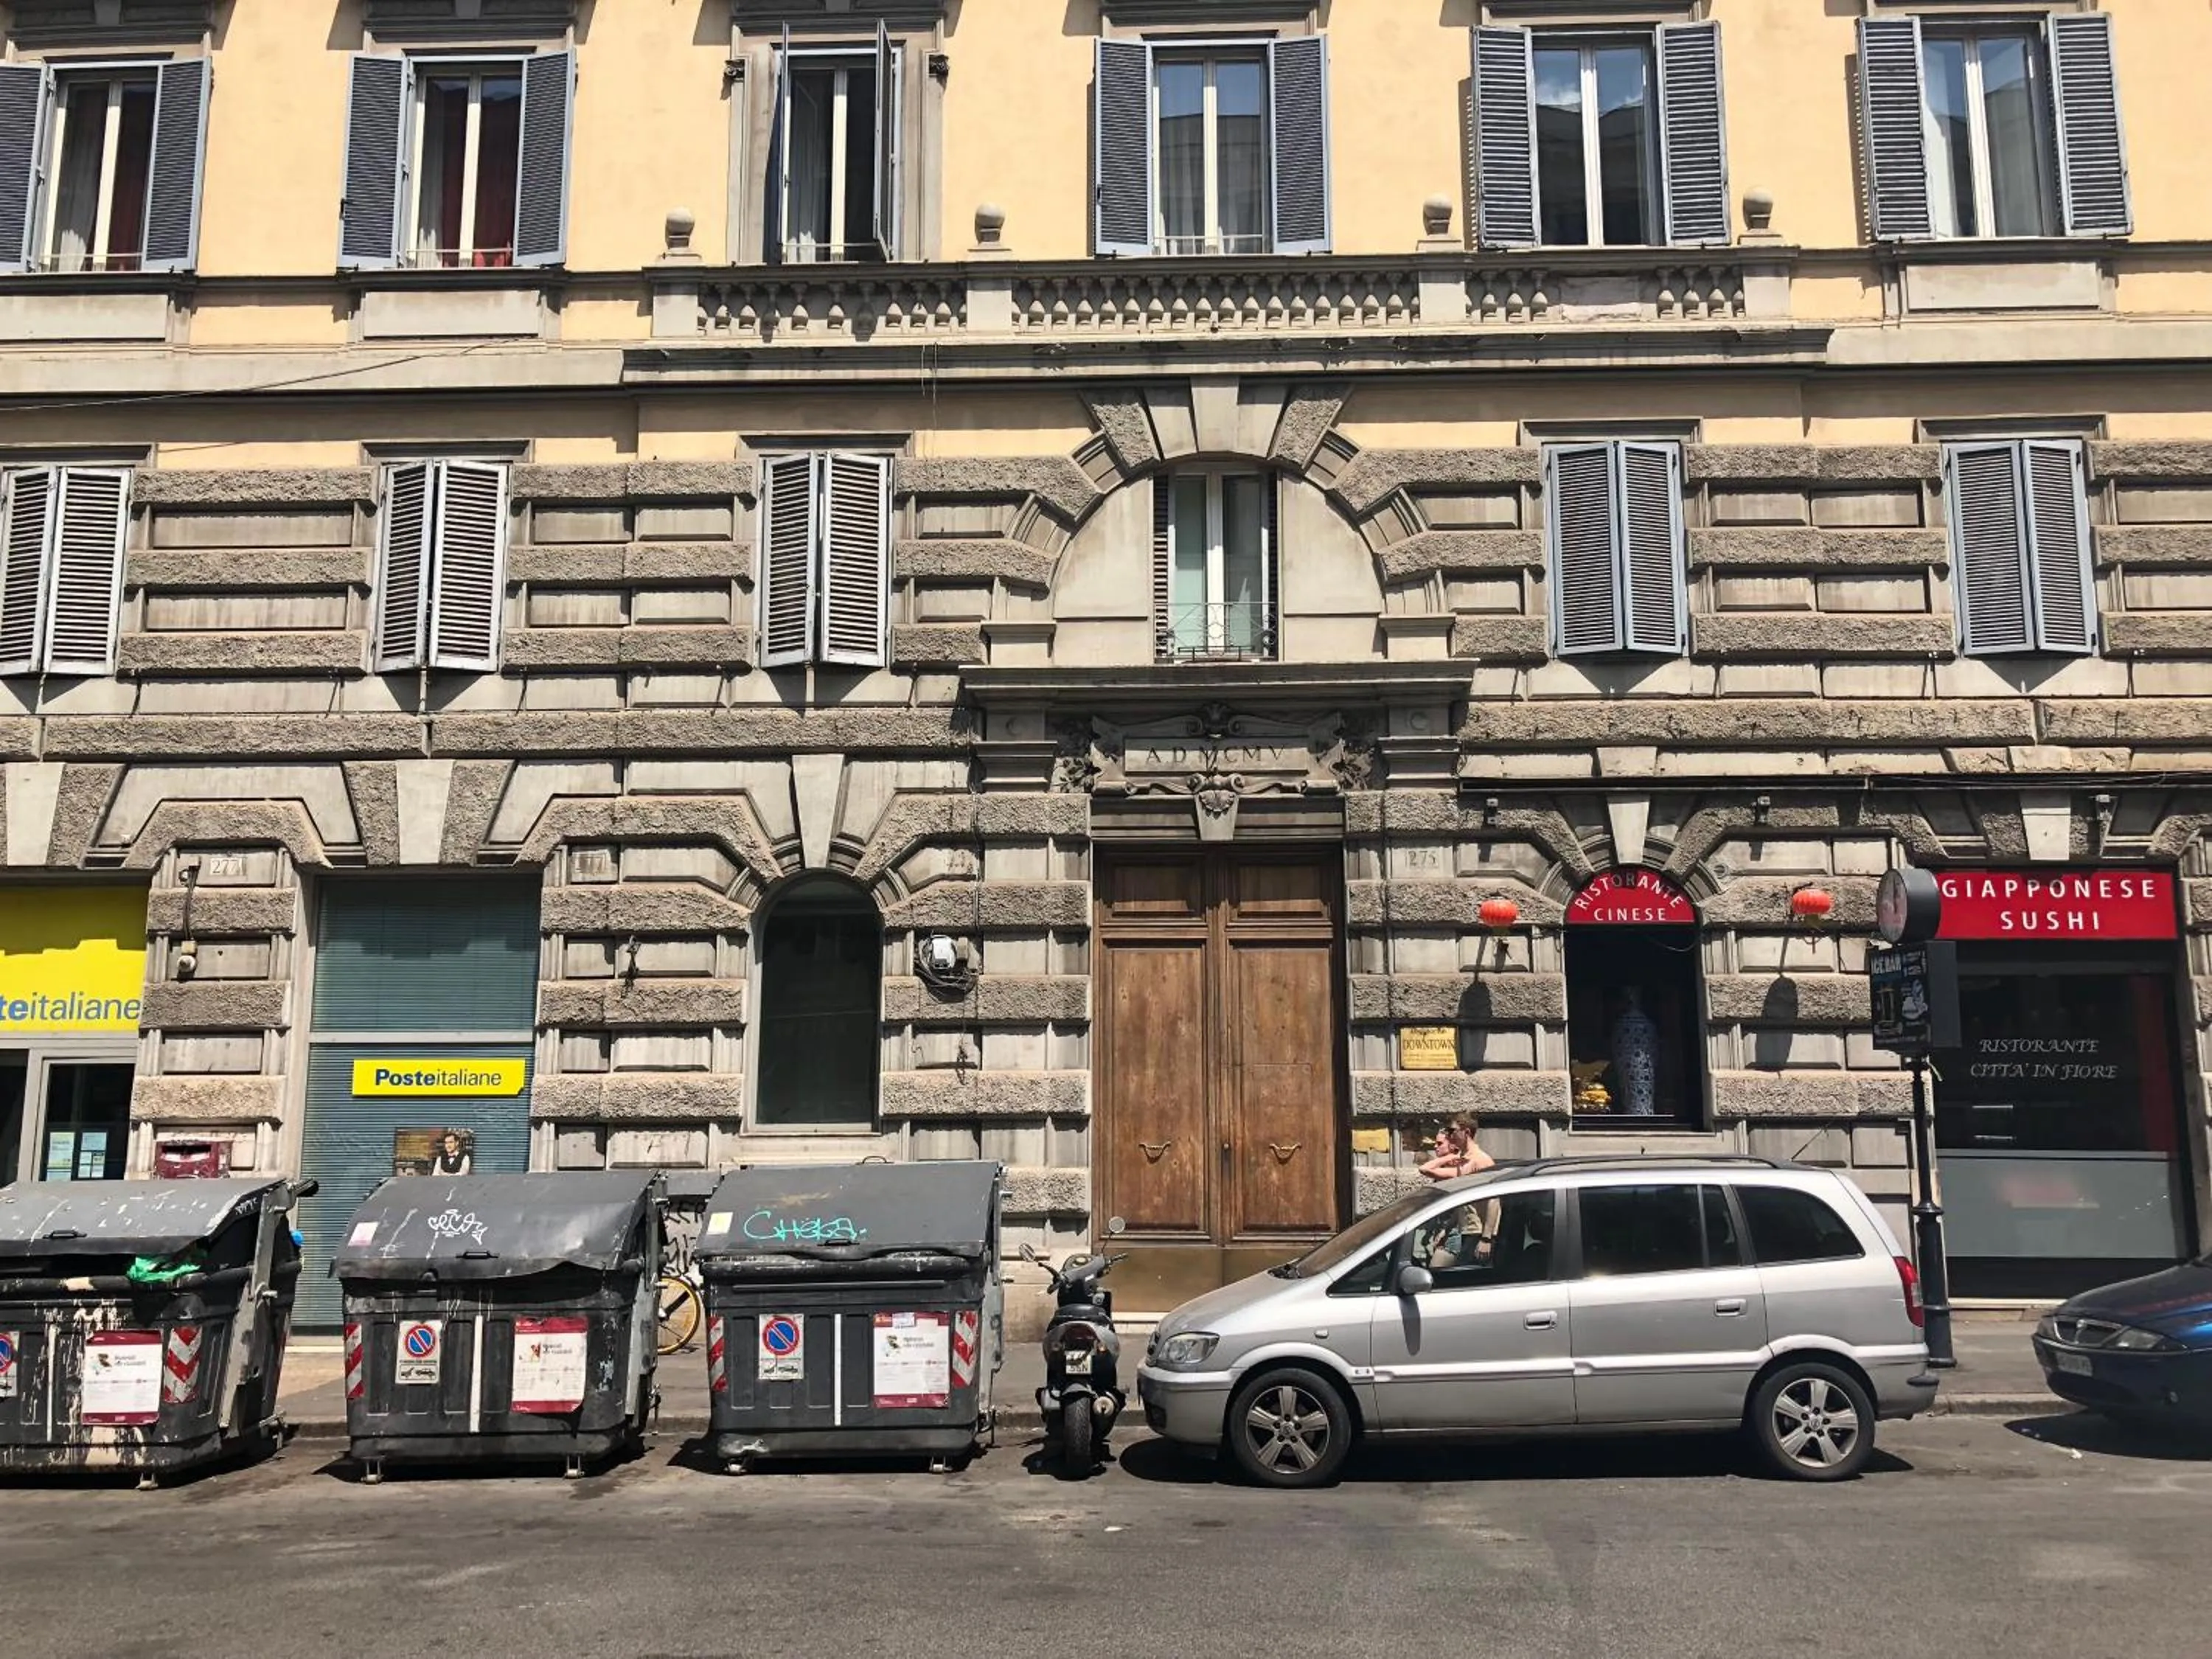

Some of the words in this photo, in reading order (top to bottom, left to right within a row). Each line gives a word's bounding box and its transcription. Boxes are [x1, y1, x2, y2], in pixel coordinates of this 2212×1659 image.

[1574, 873, 1683, 911] RISTORANTE
[1941, 879, 2155, 898] GIAPPONESE
[1593, 908, 1666, 921] CINESE
[2000, 911, 2100, 930] SUSHI
[1403, 1039, 1455, 1051] DOWNTOWN
[1979, 1038, 2099, 1053] RISTORANTE
[2033, 1063, 2059, 1078] IN
[2059, 1063, 2118, 1080] FIORE
